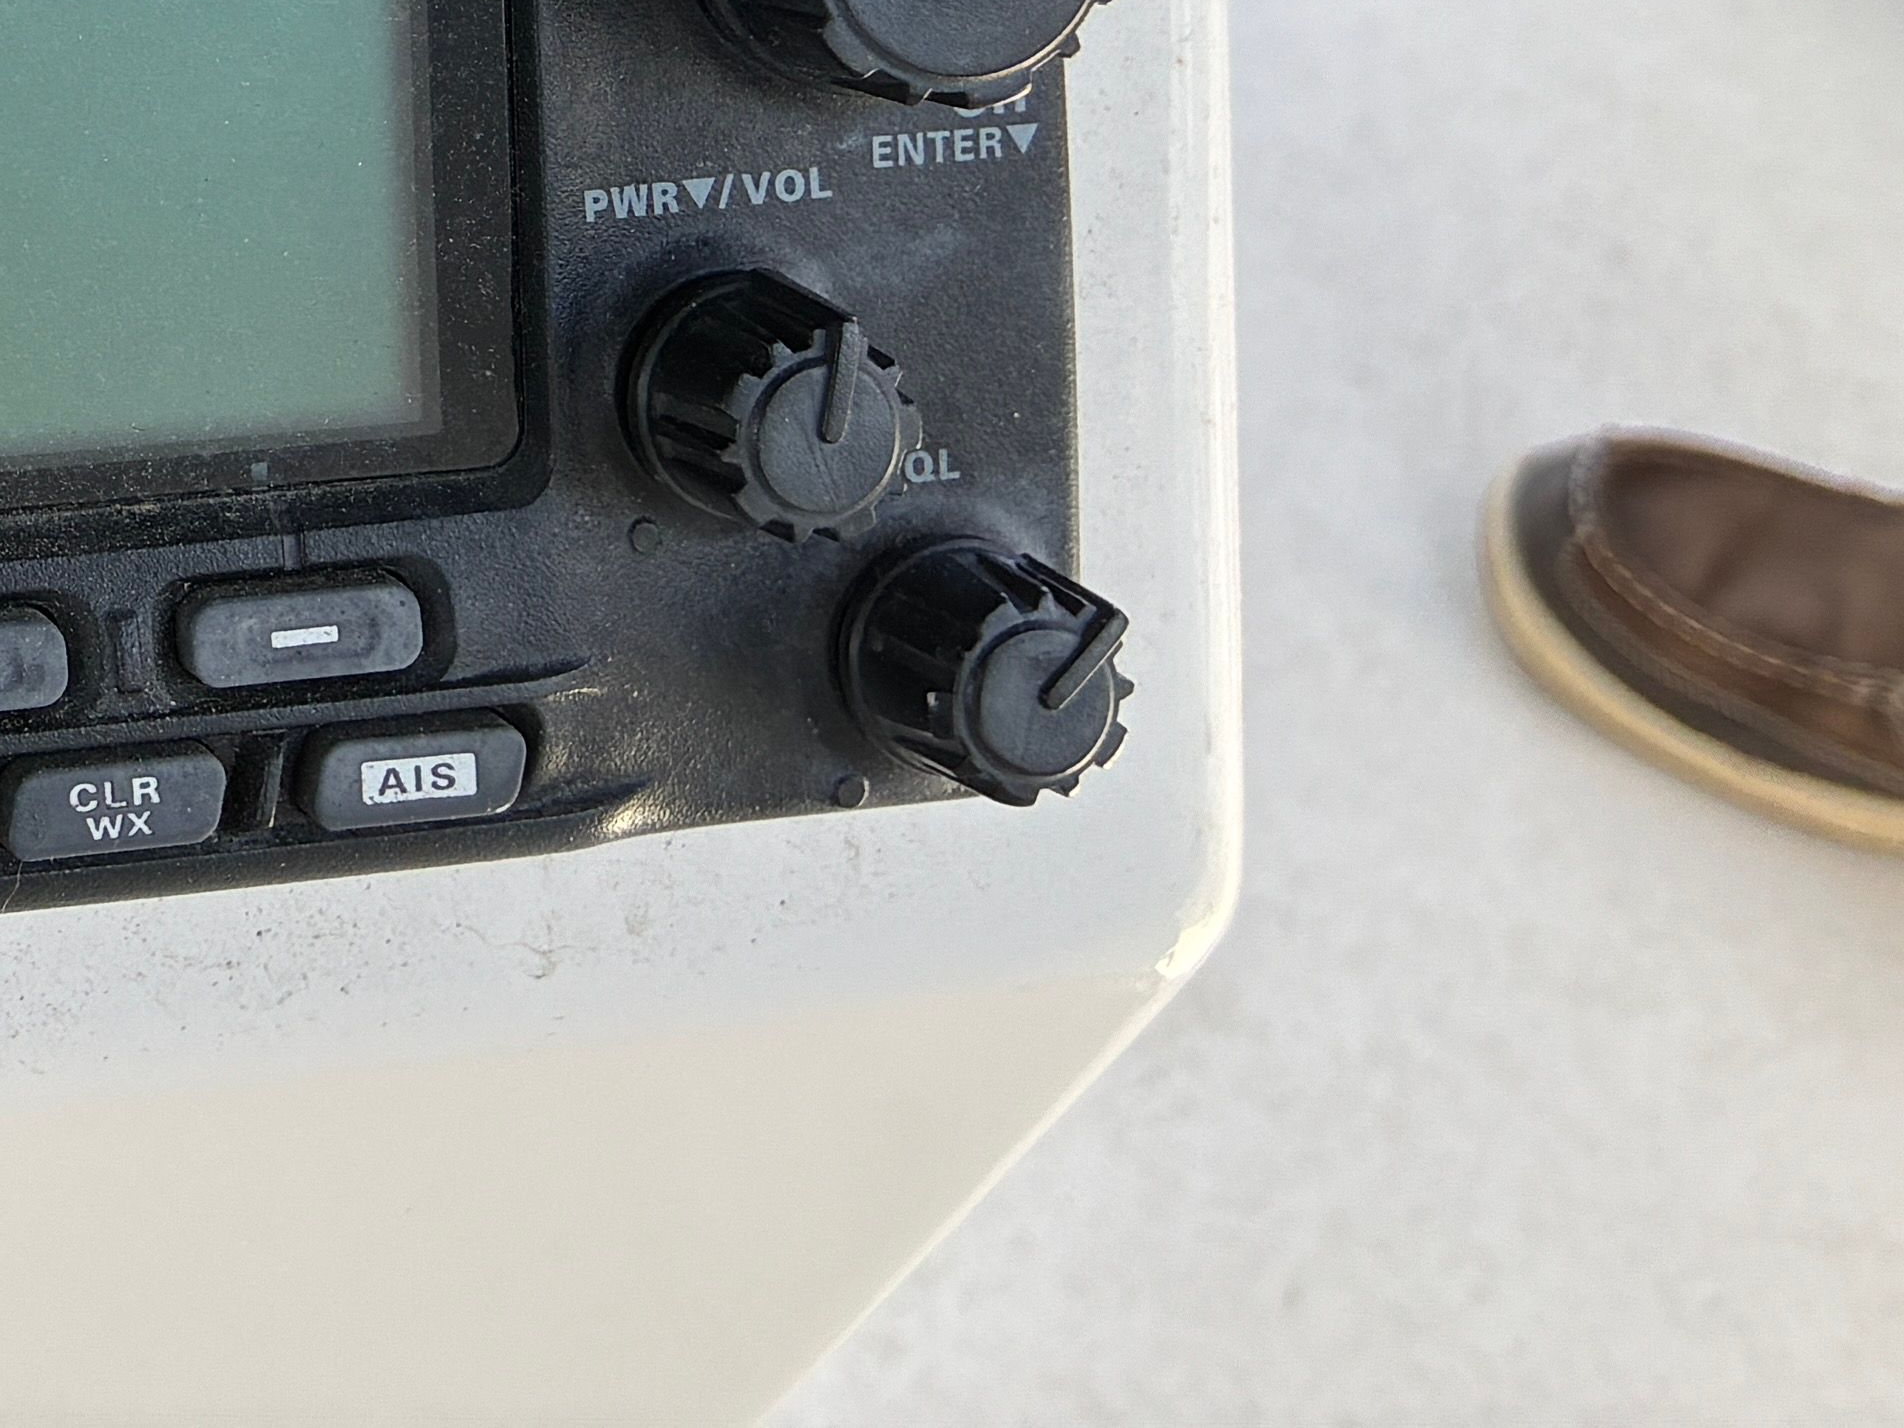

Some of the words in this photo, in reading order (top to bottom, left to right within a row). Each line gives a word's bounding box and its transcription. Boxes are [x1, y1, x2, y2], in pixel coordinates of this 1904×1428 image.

[872, 126, 1003, 168] ENTER
[68, 777, 160, 811] CLR
[378, 762, 457, 797] AIS
[85, 812, 154, 841] WX
